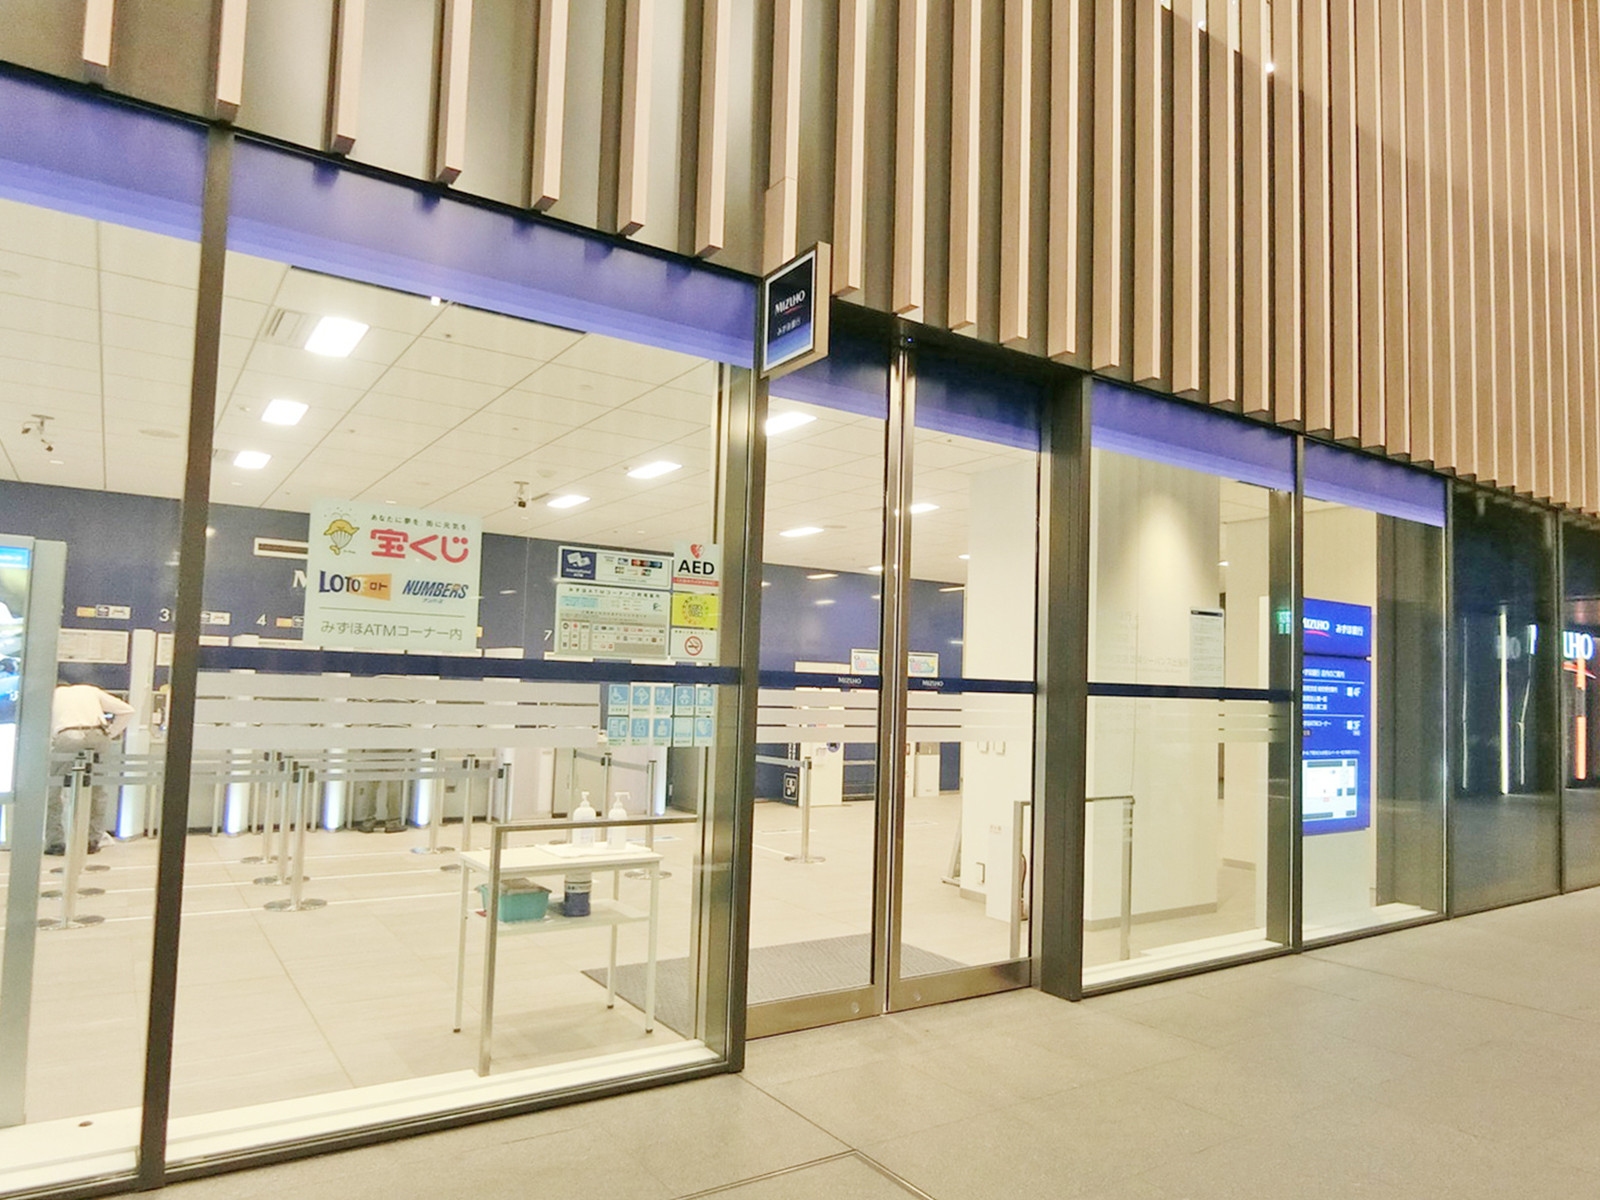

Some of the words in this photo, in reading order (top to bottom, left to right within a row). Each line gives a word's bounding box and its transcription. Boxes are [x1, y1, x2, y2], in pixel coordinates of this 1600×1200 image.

[775, 290, 806, 314] MIZUHO
[370, 529, 469, 563] 宝くじ
[678, 559, 715, 575] AED
[318, 570, 361, 593] LOTO
[402, 580, 469, 599] NUMBERS
[159, 608, 171, 622] 3
[256, 613, 268, 626] 4
[320, 620, 463, 640] みずほATMコーナー内
[543, 630, 553, 641] 7
[837, 677, 862, 685] MIZUHO
